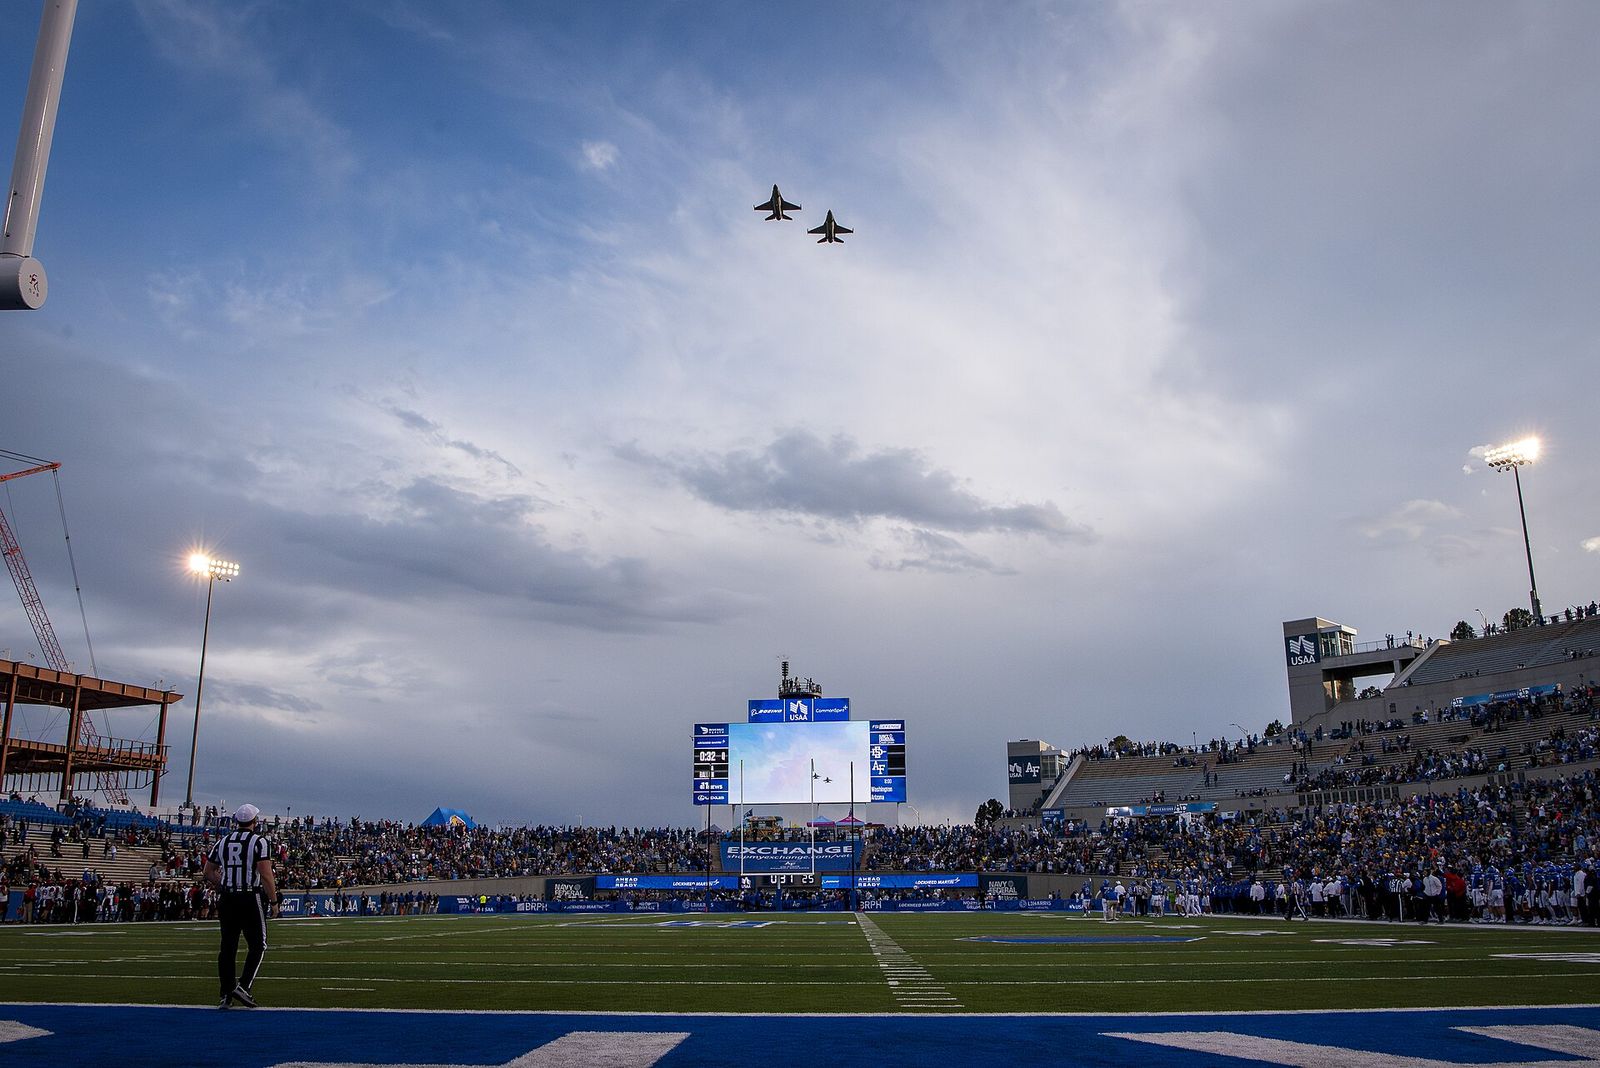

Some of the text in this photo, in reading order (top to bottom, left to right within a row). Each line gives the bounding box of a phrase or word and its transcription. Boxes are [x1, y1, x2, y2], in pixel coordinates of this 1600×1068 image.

[1291, 655, 1315, 666] USAA
[1026, 762, 1040, 777] AF
[228, 842, 242, 865] R
[727, 845, 853, 854] EXCHANGE
[802, 875, 815, 884] 25
[525, 902, 548, 911] BRPH
